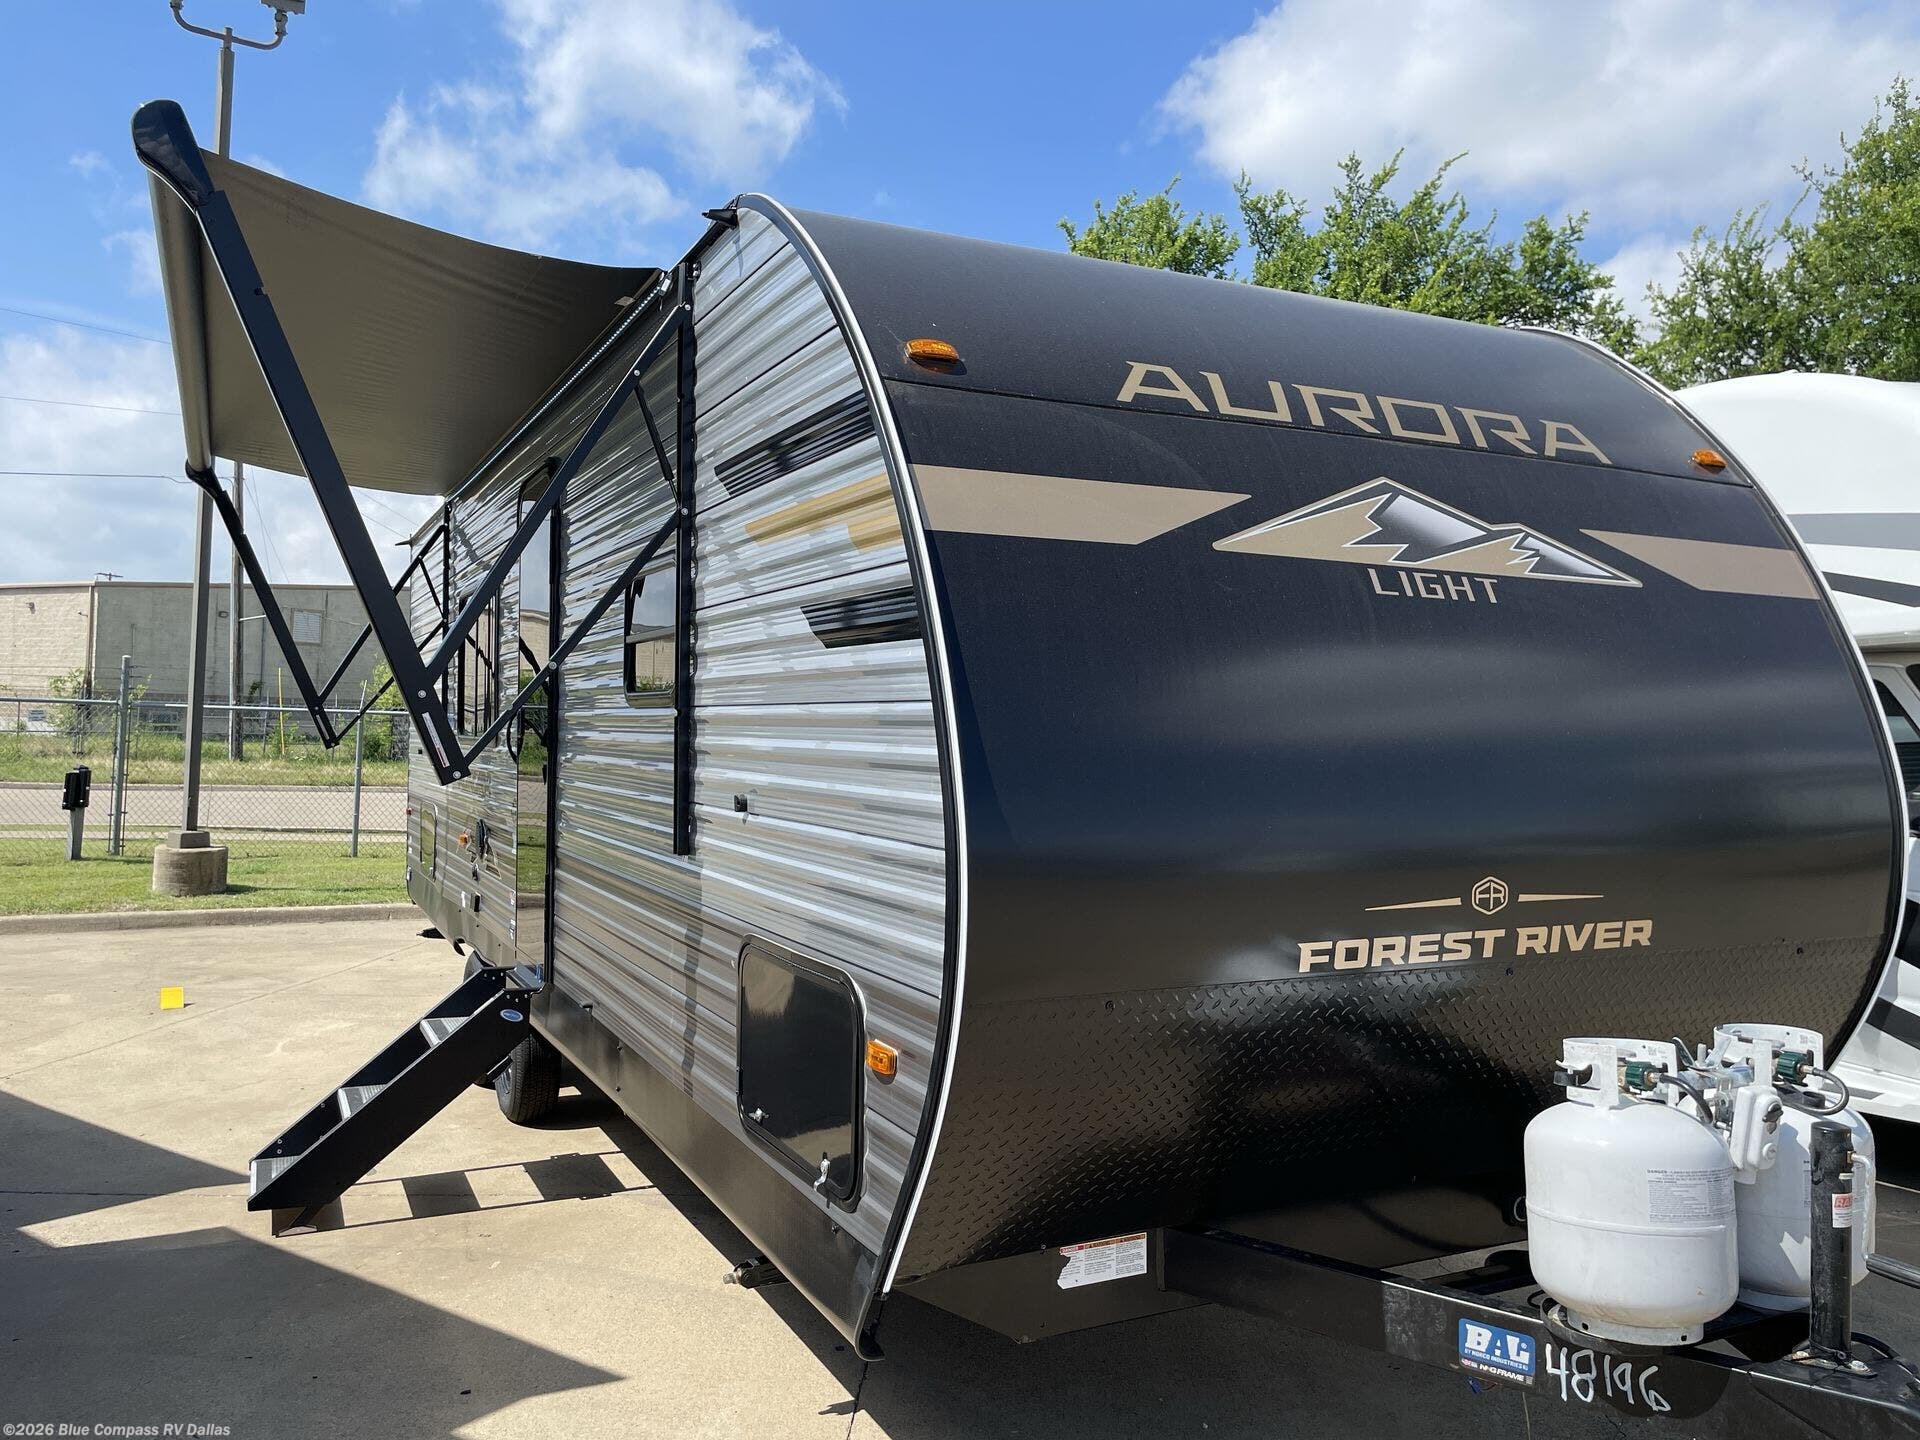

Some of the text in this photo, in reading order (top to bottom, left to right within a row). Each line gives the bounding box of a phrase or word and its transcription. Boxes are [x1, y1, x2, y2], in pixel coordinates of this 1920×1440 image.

[1116, 360, 1613, 465] AURORA
[1367, 567, 1498, 604] LIGHT
[1297, 919, 1653, 973] FOREST RIVER
[1465, 1323, 1530, 1365] BAL
[1491, 1355, 1523, 1369] INDUSTRIES
[1545, 1343, 1672, 1412] 48196
